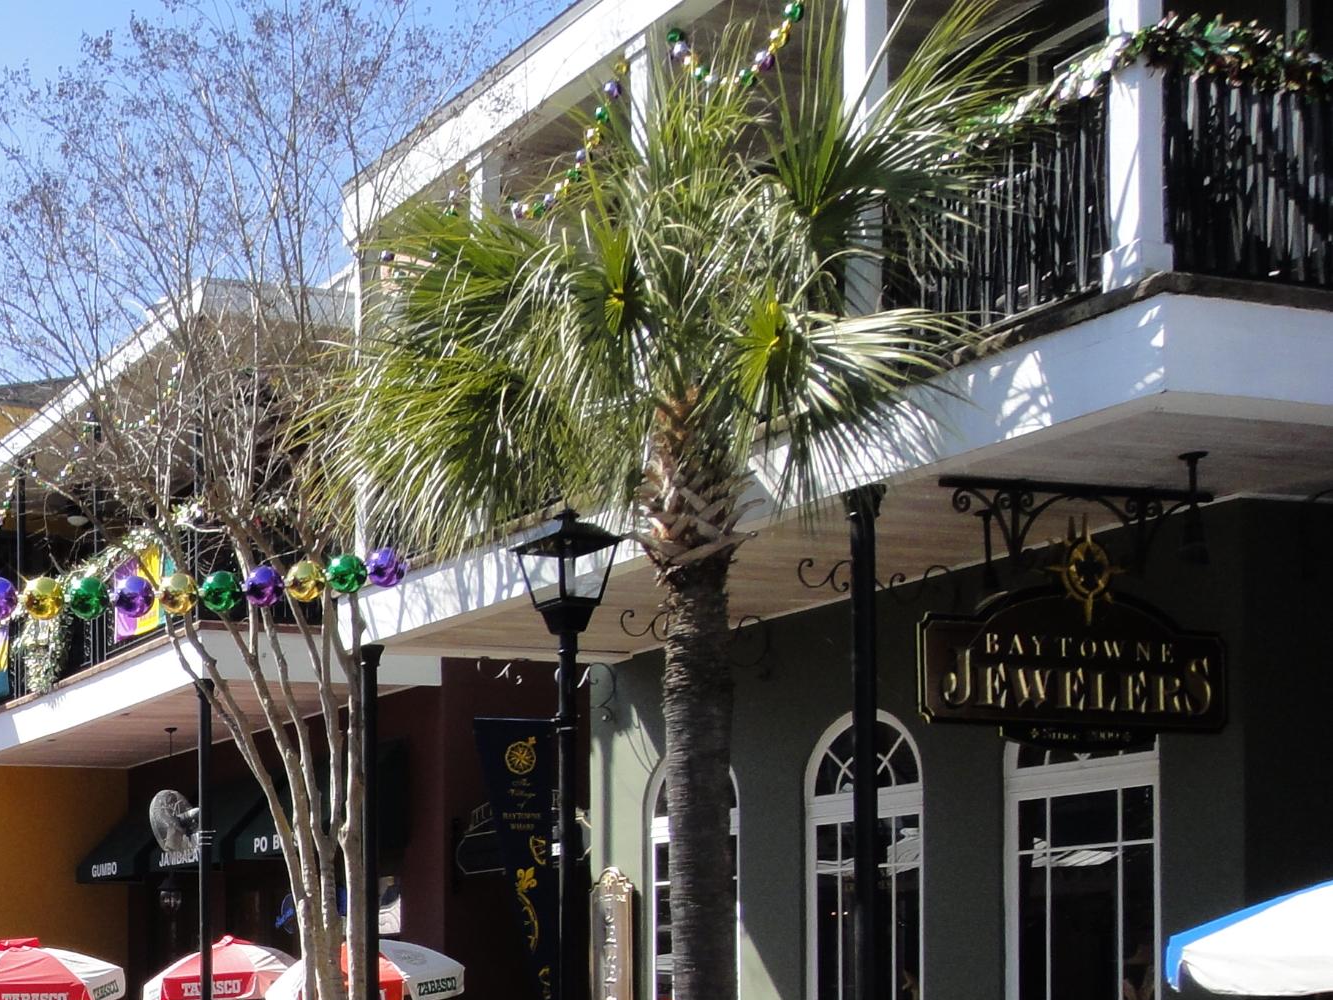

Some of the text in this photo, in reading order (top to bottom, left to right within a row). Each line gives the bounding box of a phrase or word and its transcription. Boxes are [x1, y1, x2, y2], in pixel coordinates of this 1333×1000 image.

[986, 632, 1174, 663] BAYTOWNE
[941, 648, 1212, 715] JEWELERS
[254, 836, 268, 853] PO
[159, 846, 200, 868] JAMBALA
[92, 861, 117, 878] GUMBO
[93, 980, 120, 1000] TABASCO
[181, 980, 242, 997] TASCO
[417, 976, 458, 996] TABASCO
